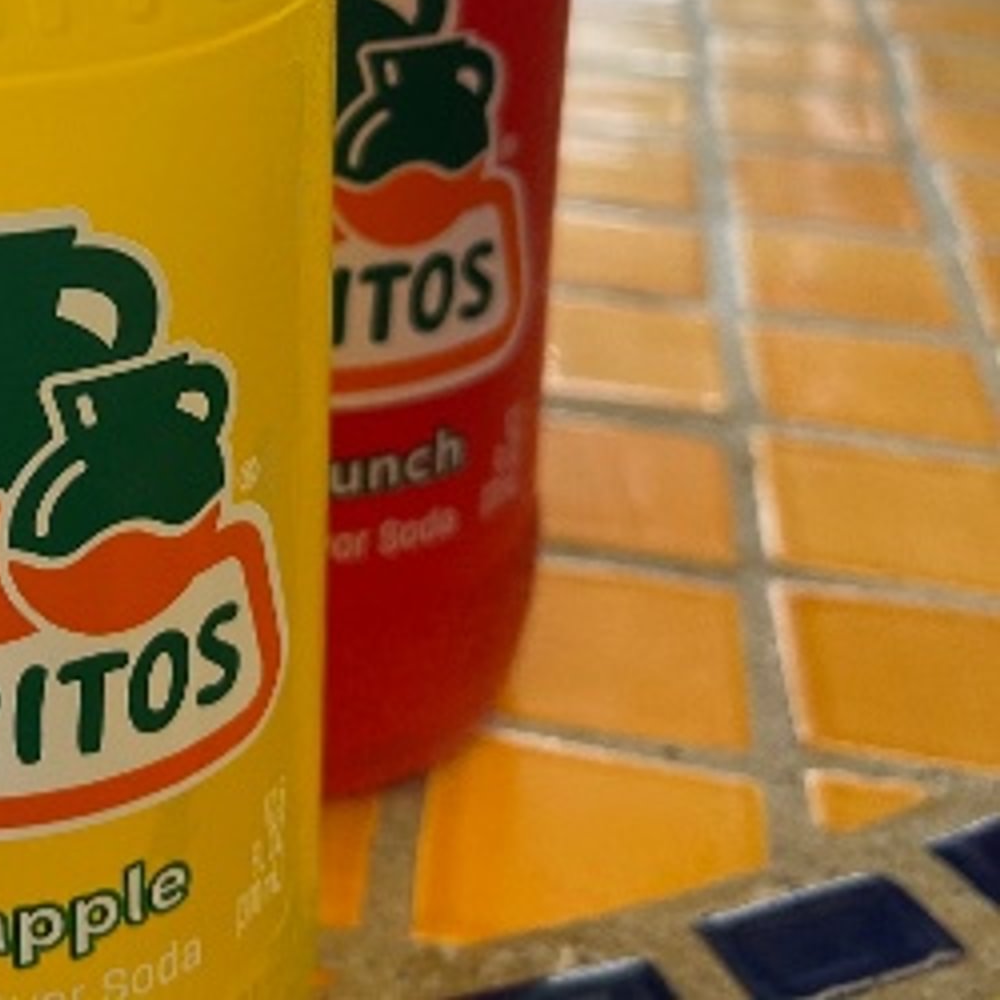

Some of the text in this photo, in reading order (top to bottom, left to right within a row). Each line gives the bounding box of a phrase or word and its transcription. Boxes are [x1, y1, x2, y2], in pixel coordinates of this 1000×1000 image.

[333, 239, 495, 346] ITOS
[330, 430, 465, 495] unch
[103, 937, 202, 1000] Soda
